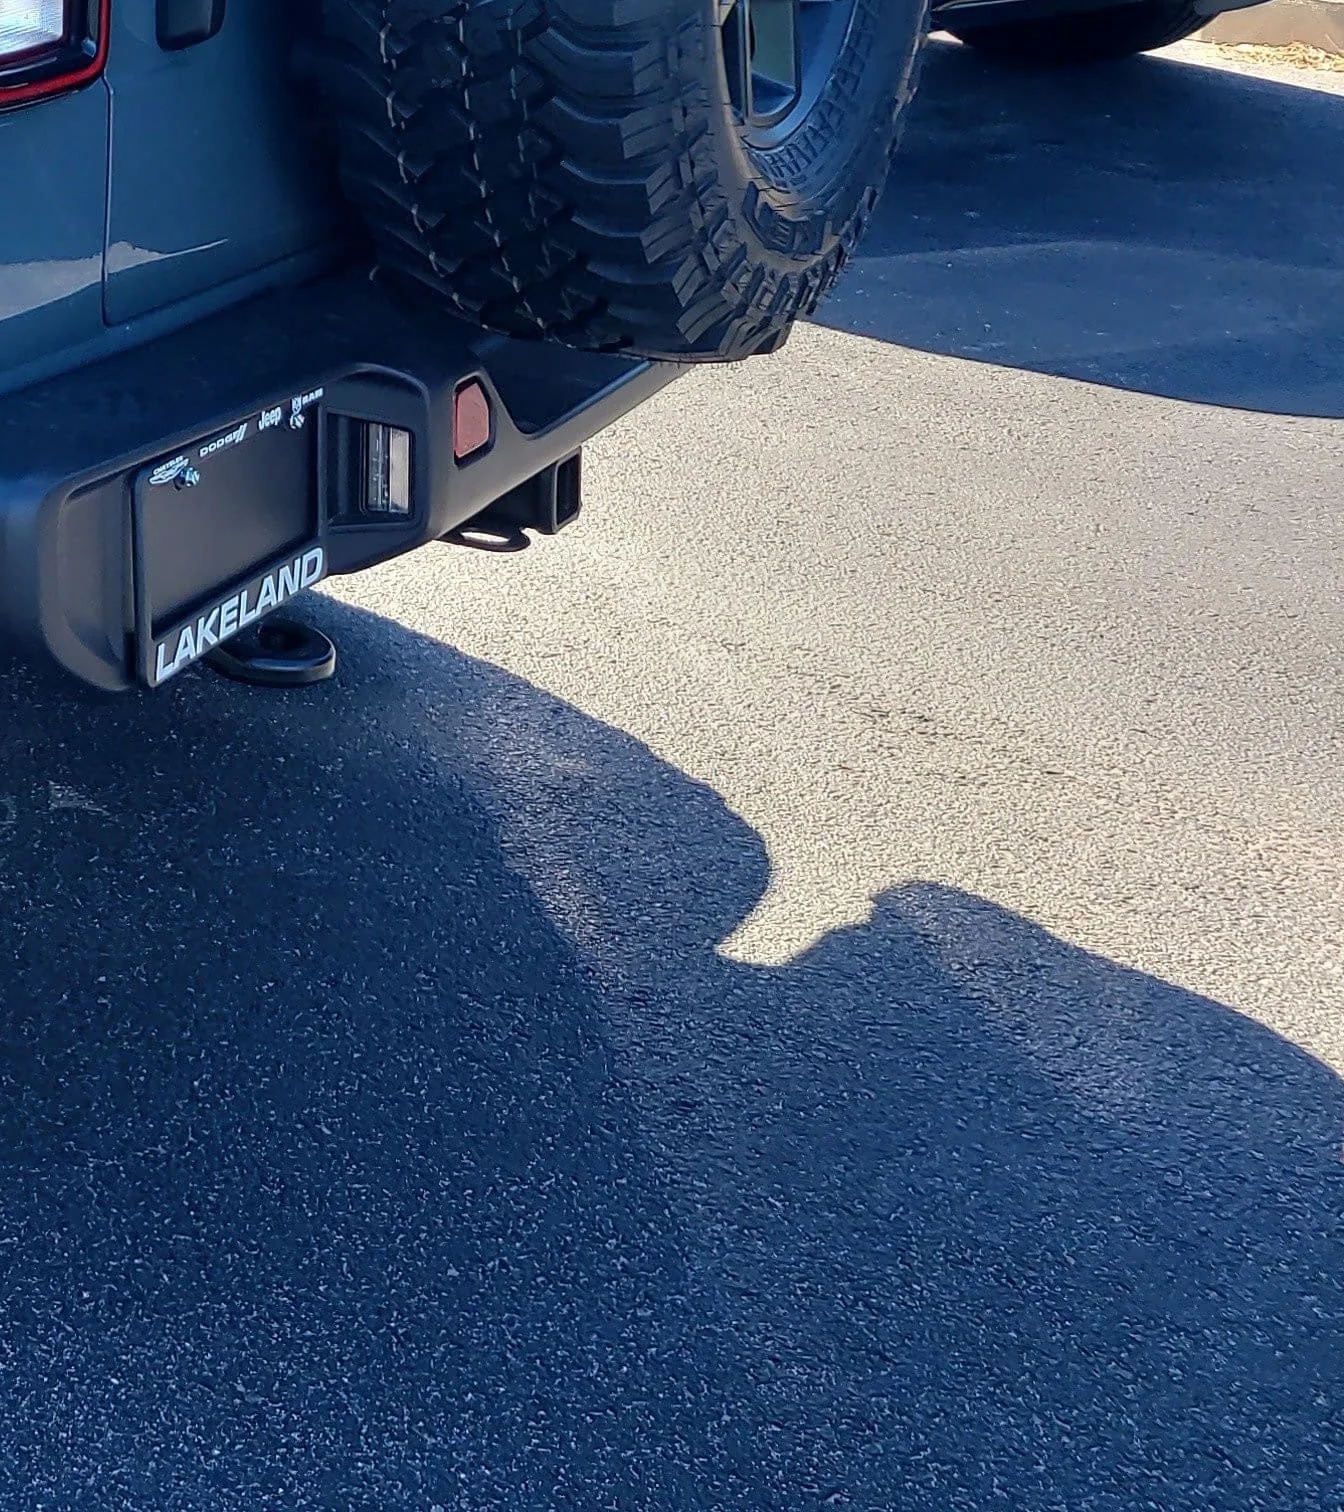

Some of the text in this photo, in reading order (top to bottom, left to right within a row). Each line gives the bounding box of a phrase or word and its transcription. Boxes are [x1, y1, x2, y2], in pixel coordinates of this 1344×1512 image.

[258, 406, 282, 431] Jeep
[302, 388, 324, 406] RAM
[156, 547, 324, 682] LAKELAND
